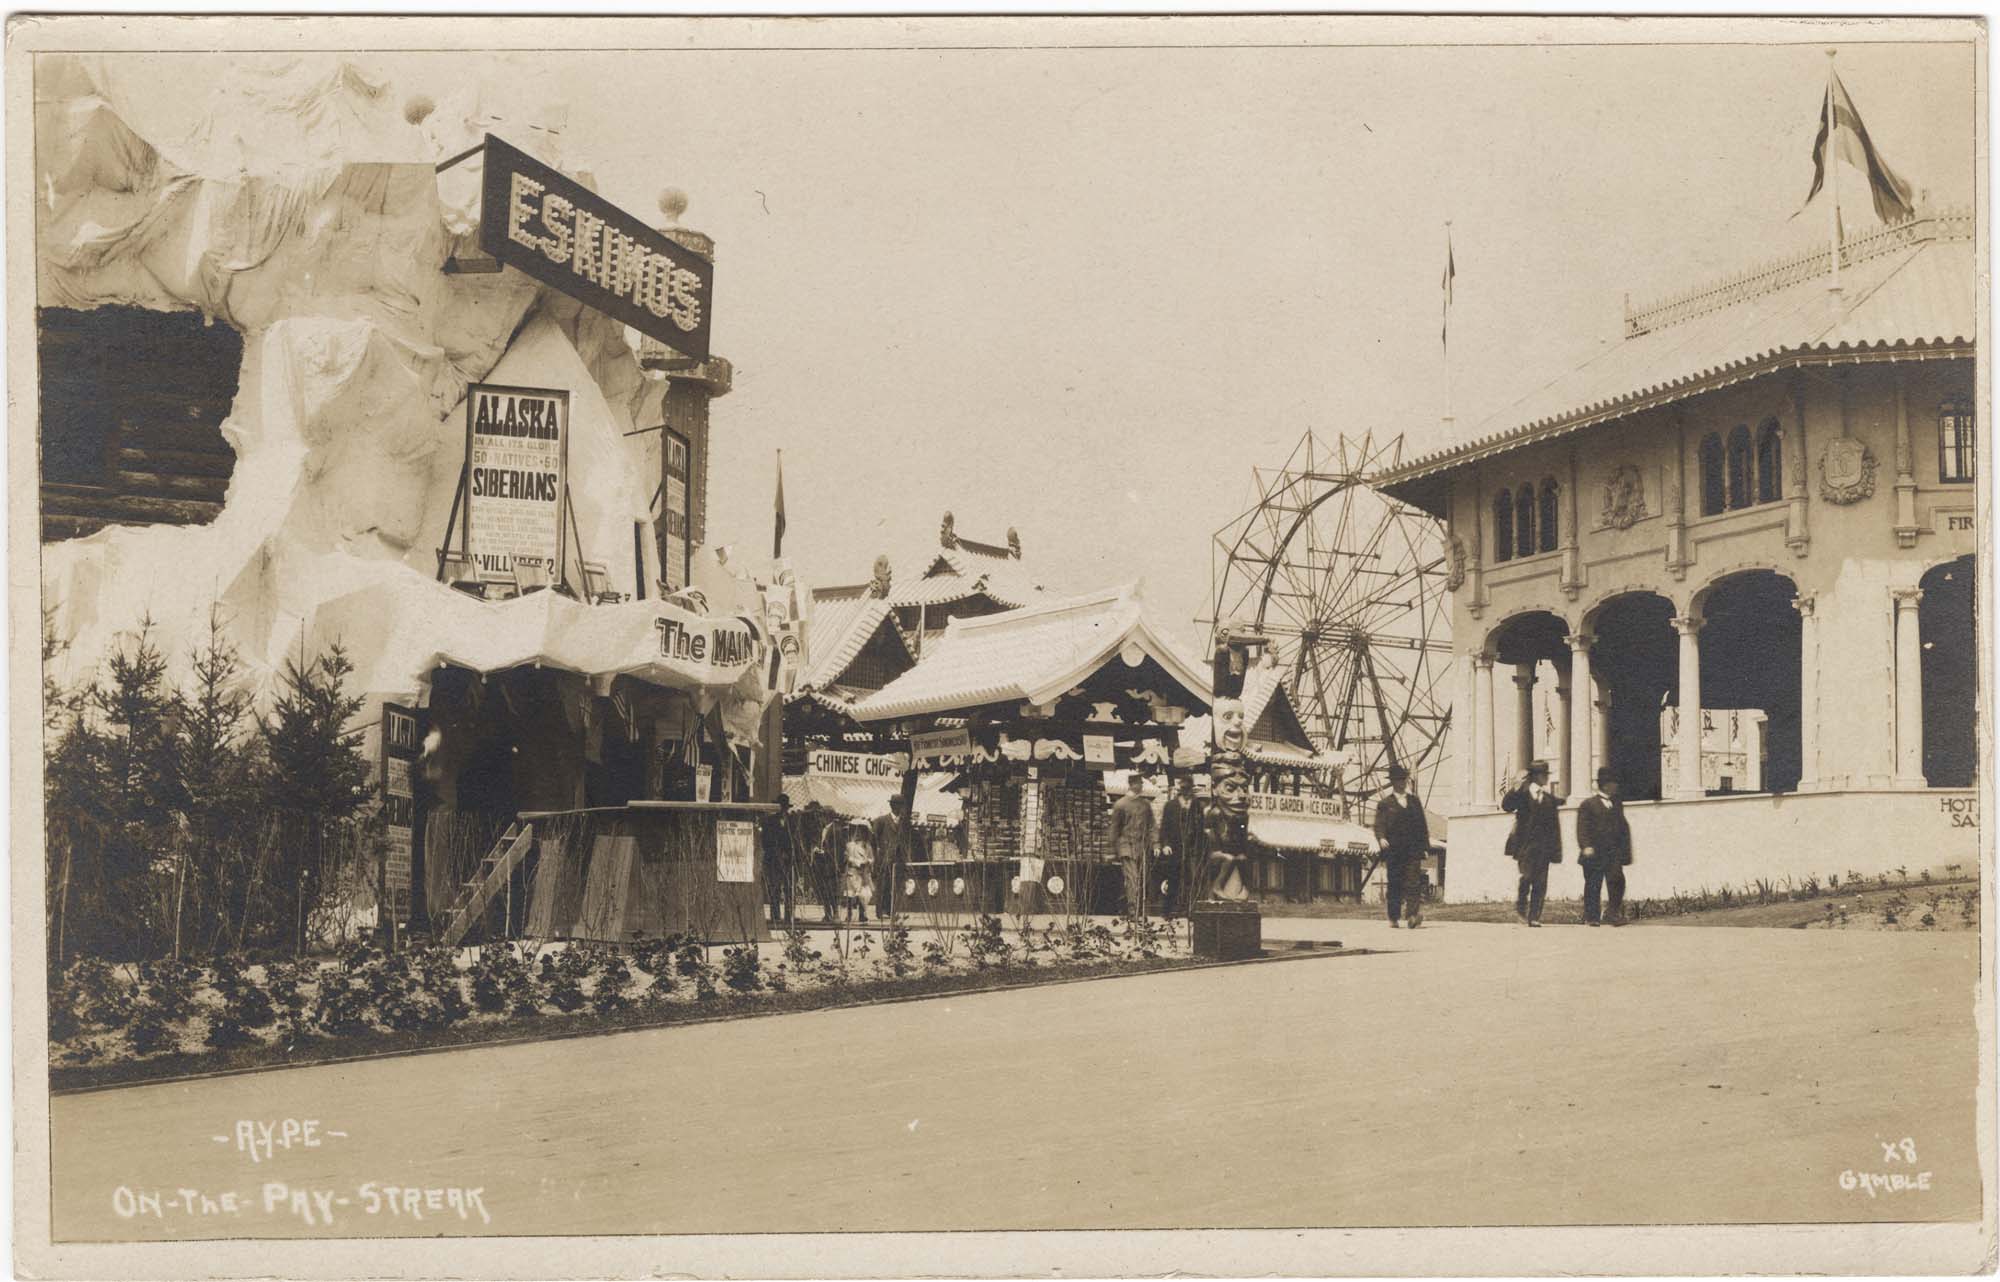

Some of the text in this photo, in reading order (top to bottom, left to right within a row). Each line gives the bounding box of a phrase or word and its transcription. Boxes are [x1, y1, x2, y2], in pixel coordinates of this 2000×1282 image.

[508, 172, 702, 332] ESKIMOS
[475, 394, 559, 440] ALASKA
[474, 451, 558, 469] 50 NATIVES 50
[473, 467, 557, 502] SIBERIANS
[655, 617, 706, 663] The
[711, 628, 753, 668] MAIN
[1265, 796, 1276, 811] TEA
[1280, 797, 1304, 813] GARDEN
[1310, 799, 1320, 815] ICE
[1321, 802, 1341, 817] CREAM
[1940, 798, 1977, 813] HOT
[1951, 813, 1979, 828] SA
